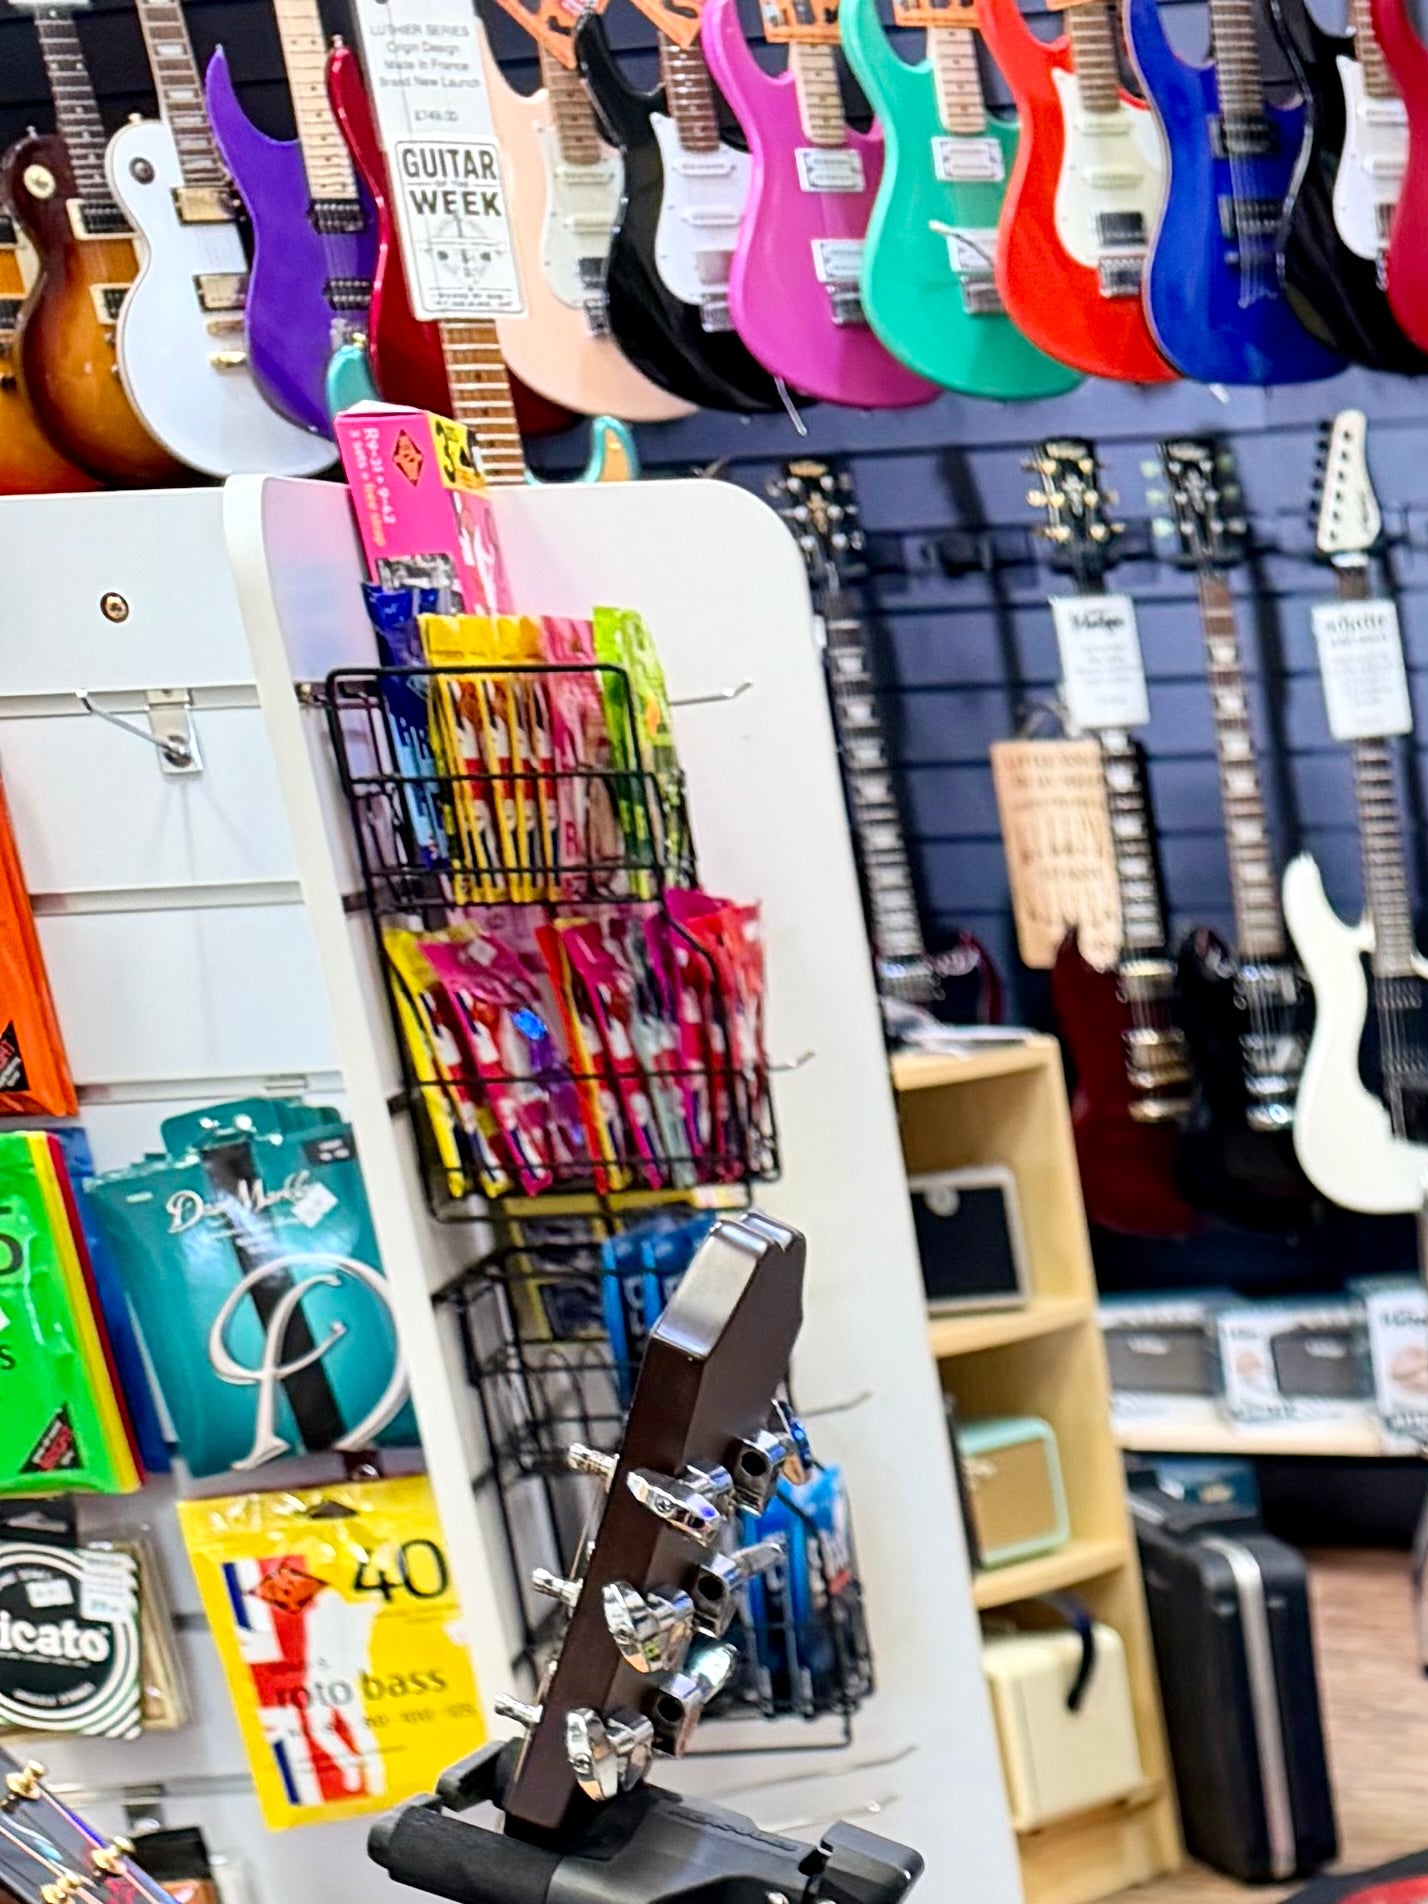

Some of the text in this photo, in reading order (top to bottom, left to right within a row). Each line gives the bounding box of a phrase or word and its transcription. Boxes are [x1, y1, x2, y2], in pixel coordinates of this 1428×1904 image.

[431, 60, 469, 71] France
[413, 77, 438, 87] New
[441, 77, 480, 88] Launch
[402, 148, 497, 180] GUITAR
[409, 190, 502, 216] WEEK
[353, 1539, 447, 1603] 40
[358, 1667, 447, 1701] bass
